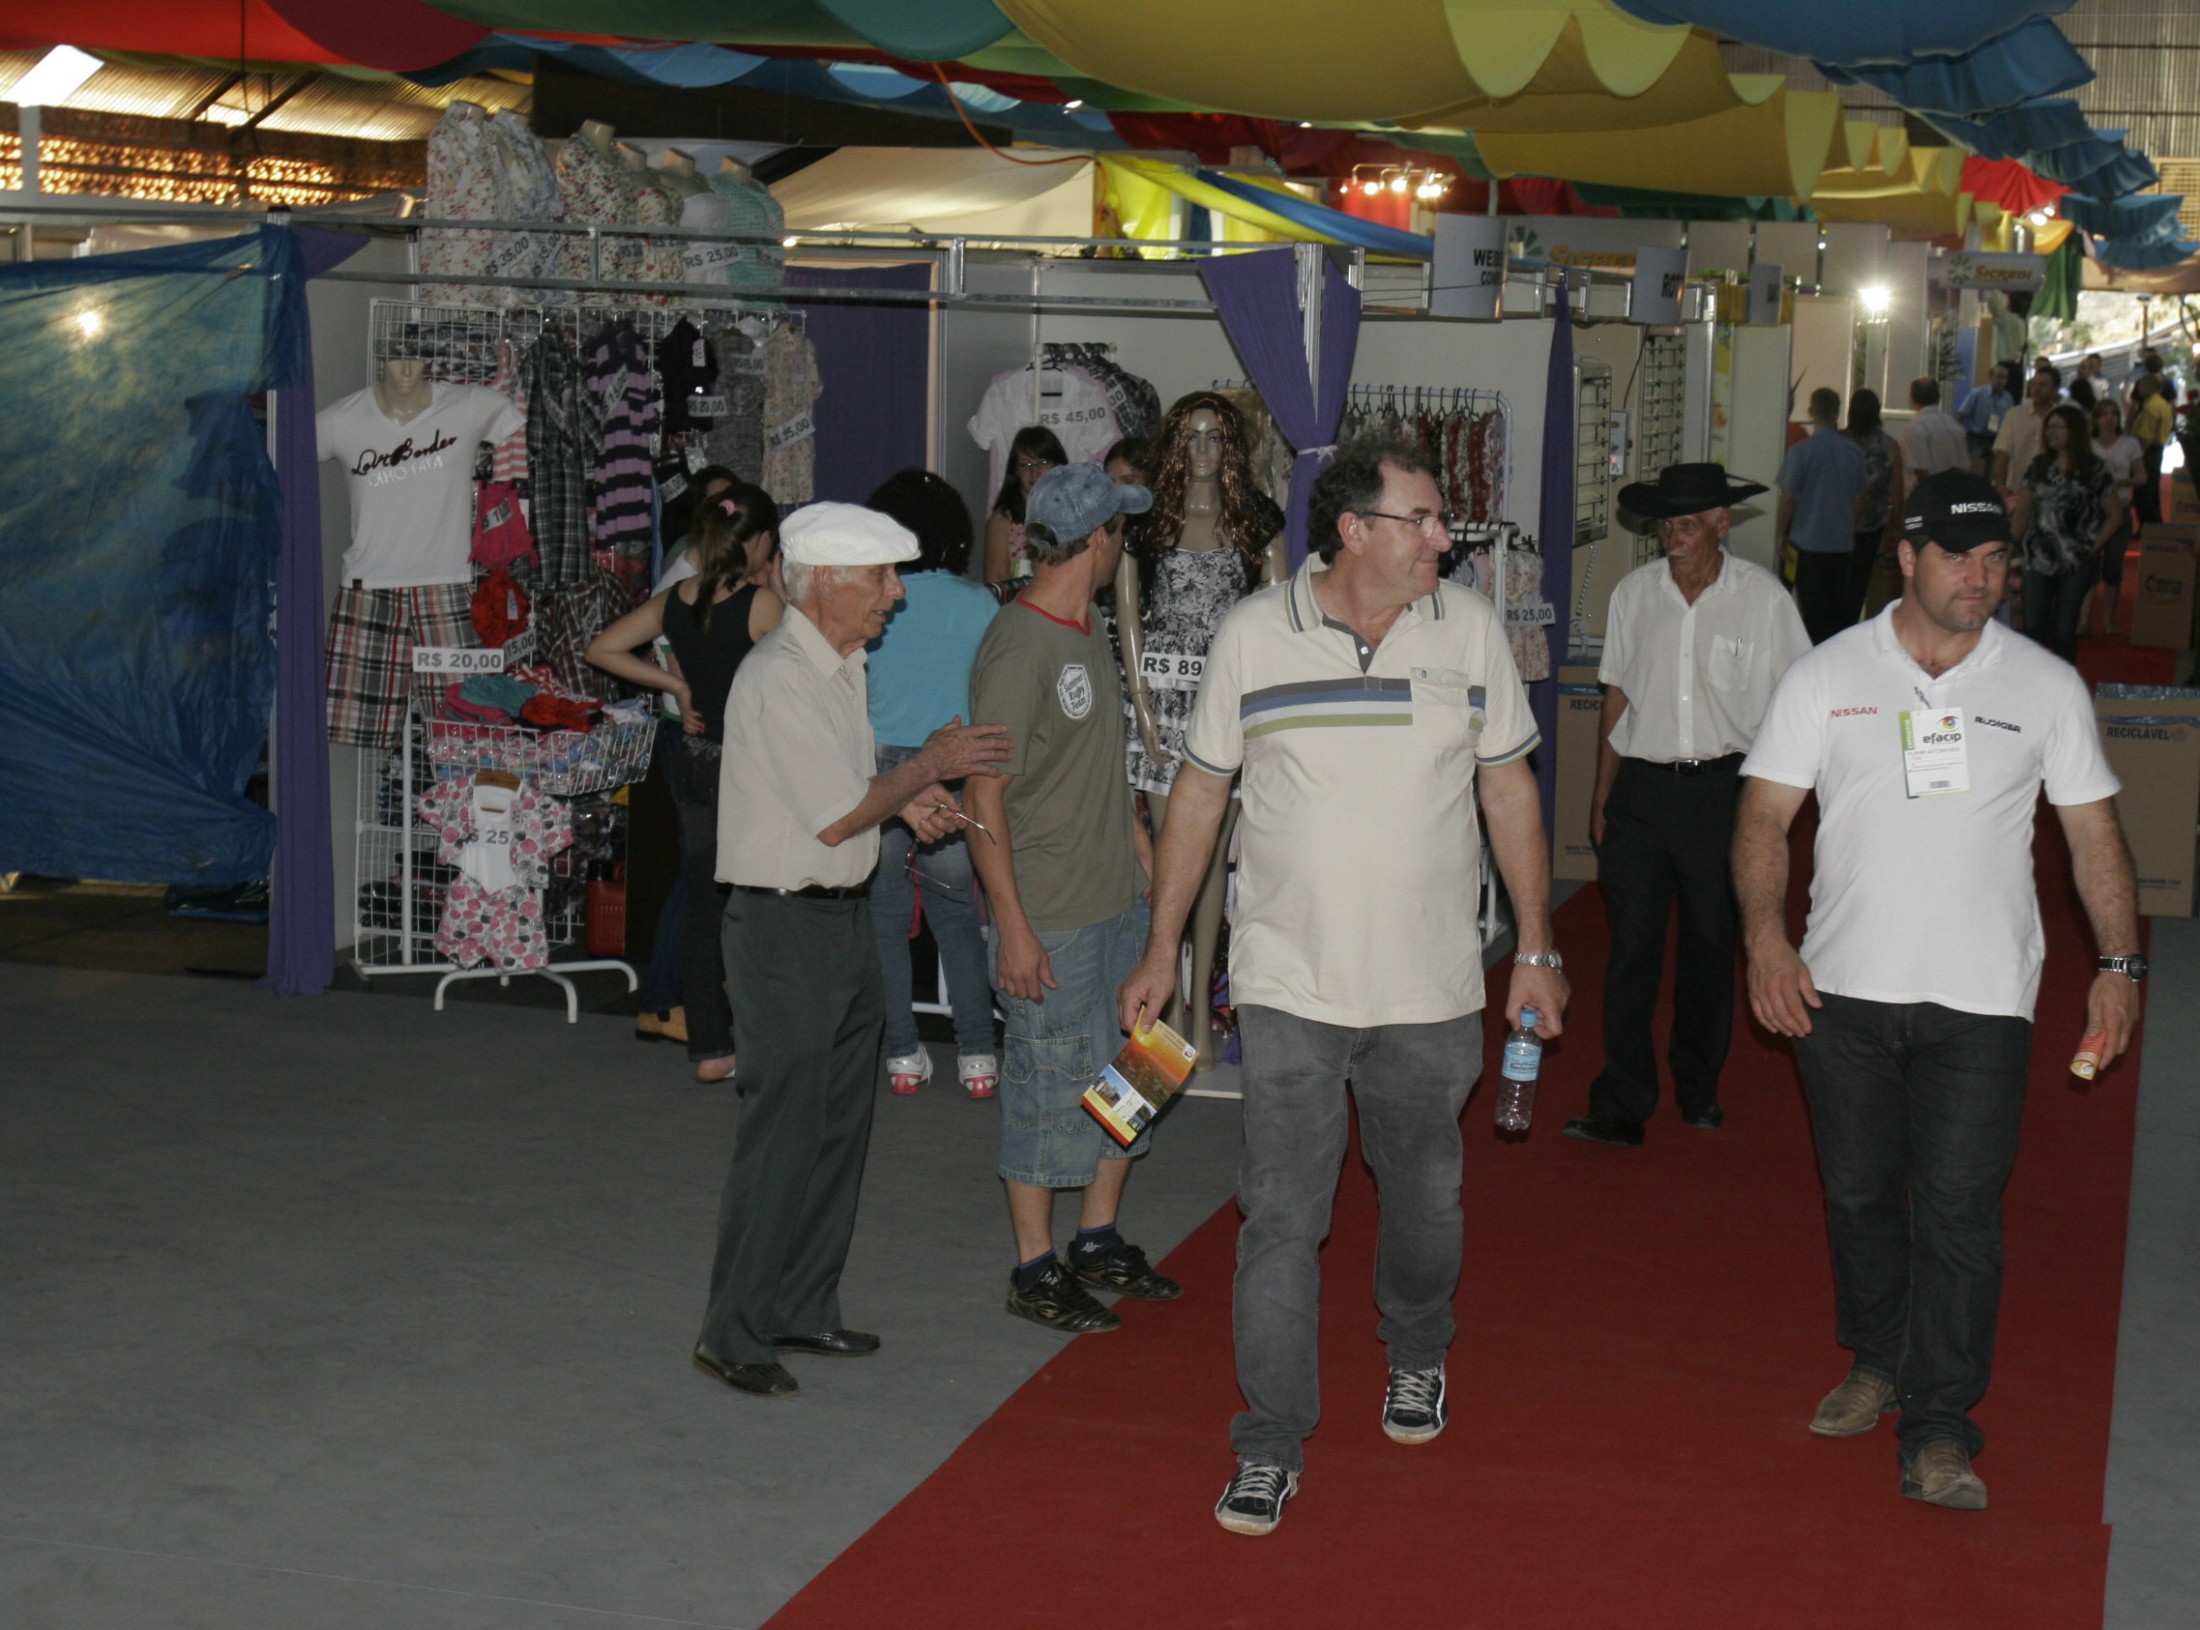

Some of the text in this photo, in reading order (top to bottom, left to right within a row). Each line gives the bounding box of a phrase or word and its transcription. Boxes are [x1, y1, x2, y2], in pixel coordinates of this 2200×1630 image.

[706, 246, 739, 264] 25,00
[1065, 407, 1106, 424] 45,00
[1522, 607, 1552, 624] 25,00
[417, 652, 501, 671] R$ 20,00
[1143, 656, 1203, 676] R$ 89
[1831, 706, 1878, 718] NISSAN
[1922, 733, 1962, 745] efacip
